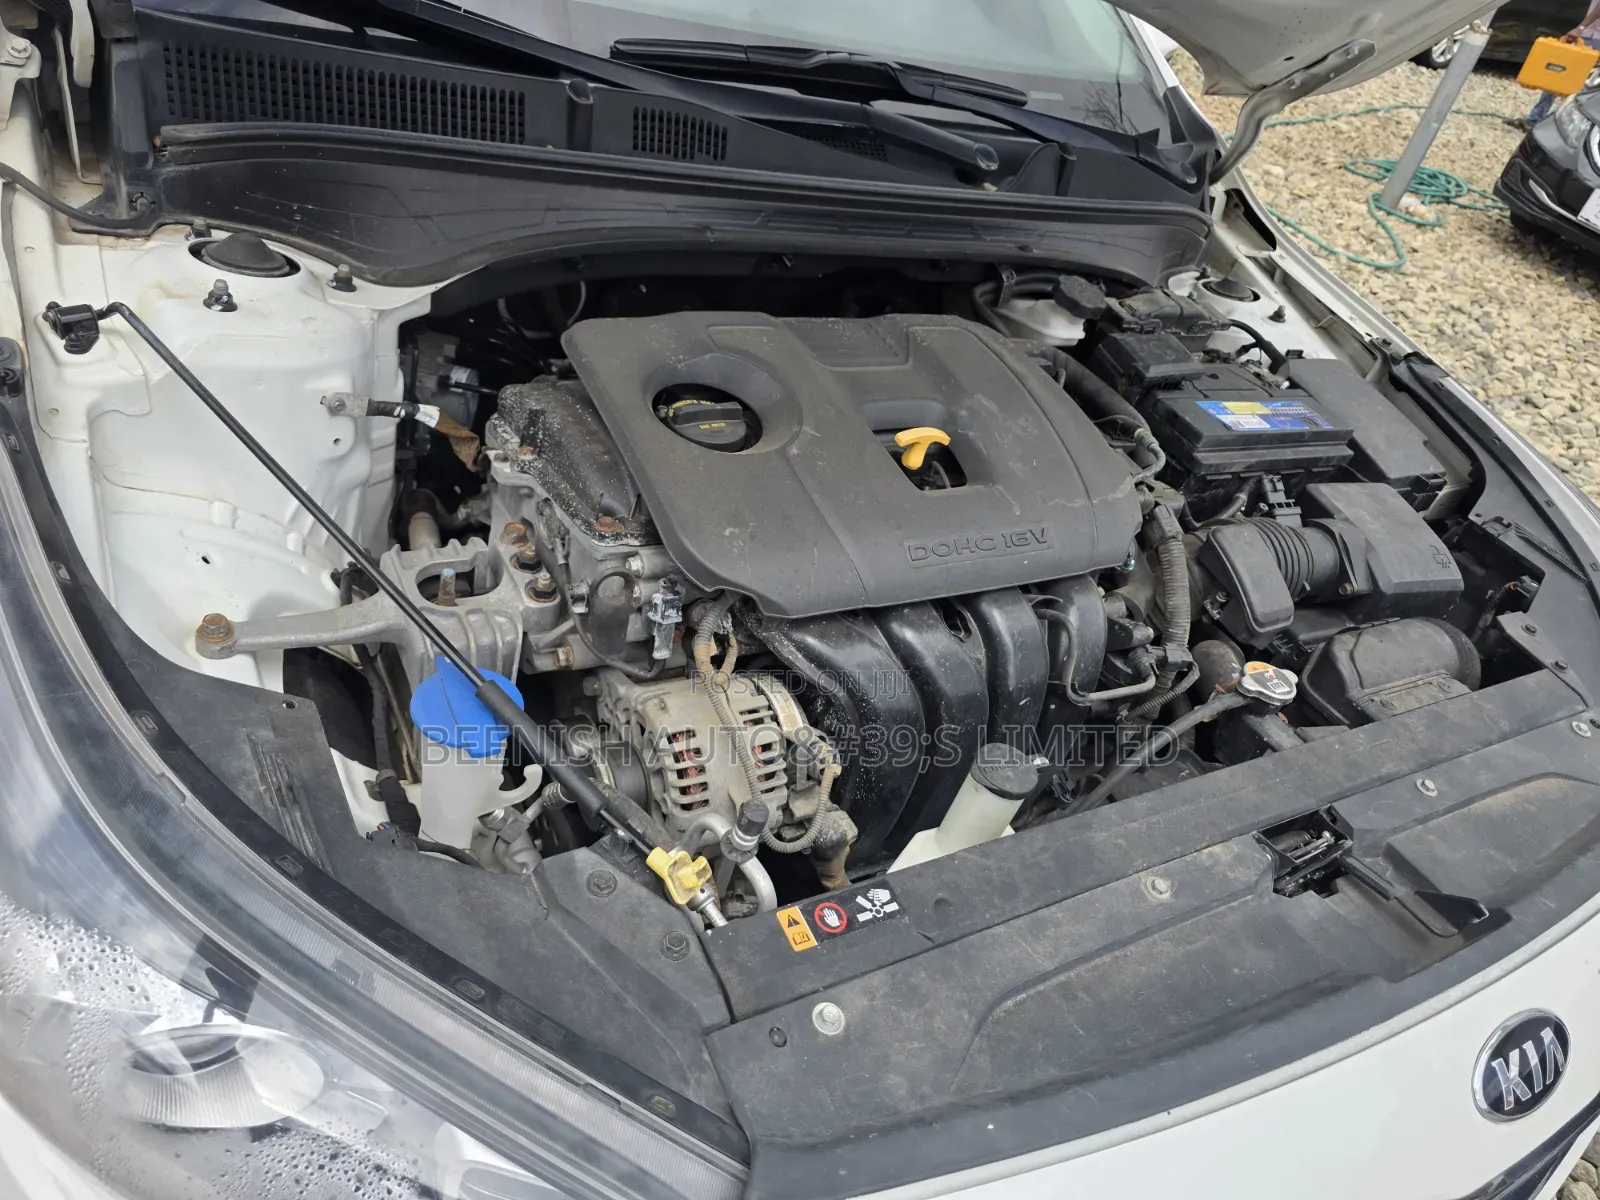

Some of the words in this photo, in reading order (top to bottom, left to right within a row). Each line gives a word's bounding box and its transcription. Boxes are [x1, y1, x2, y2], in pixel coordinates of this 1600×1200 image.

[906, 535, 998, 562] DOHC
[1002, 527, 1048, 550] 16V
[1491, 1026, 1566, 1111] KIA
